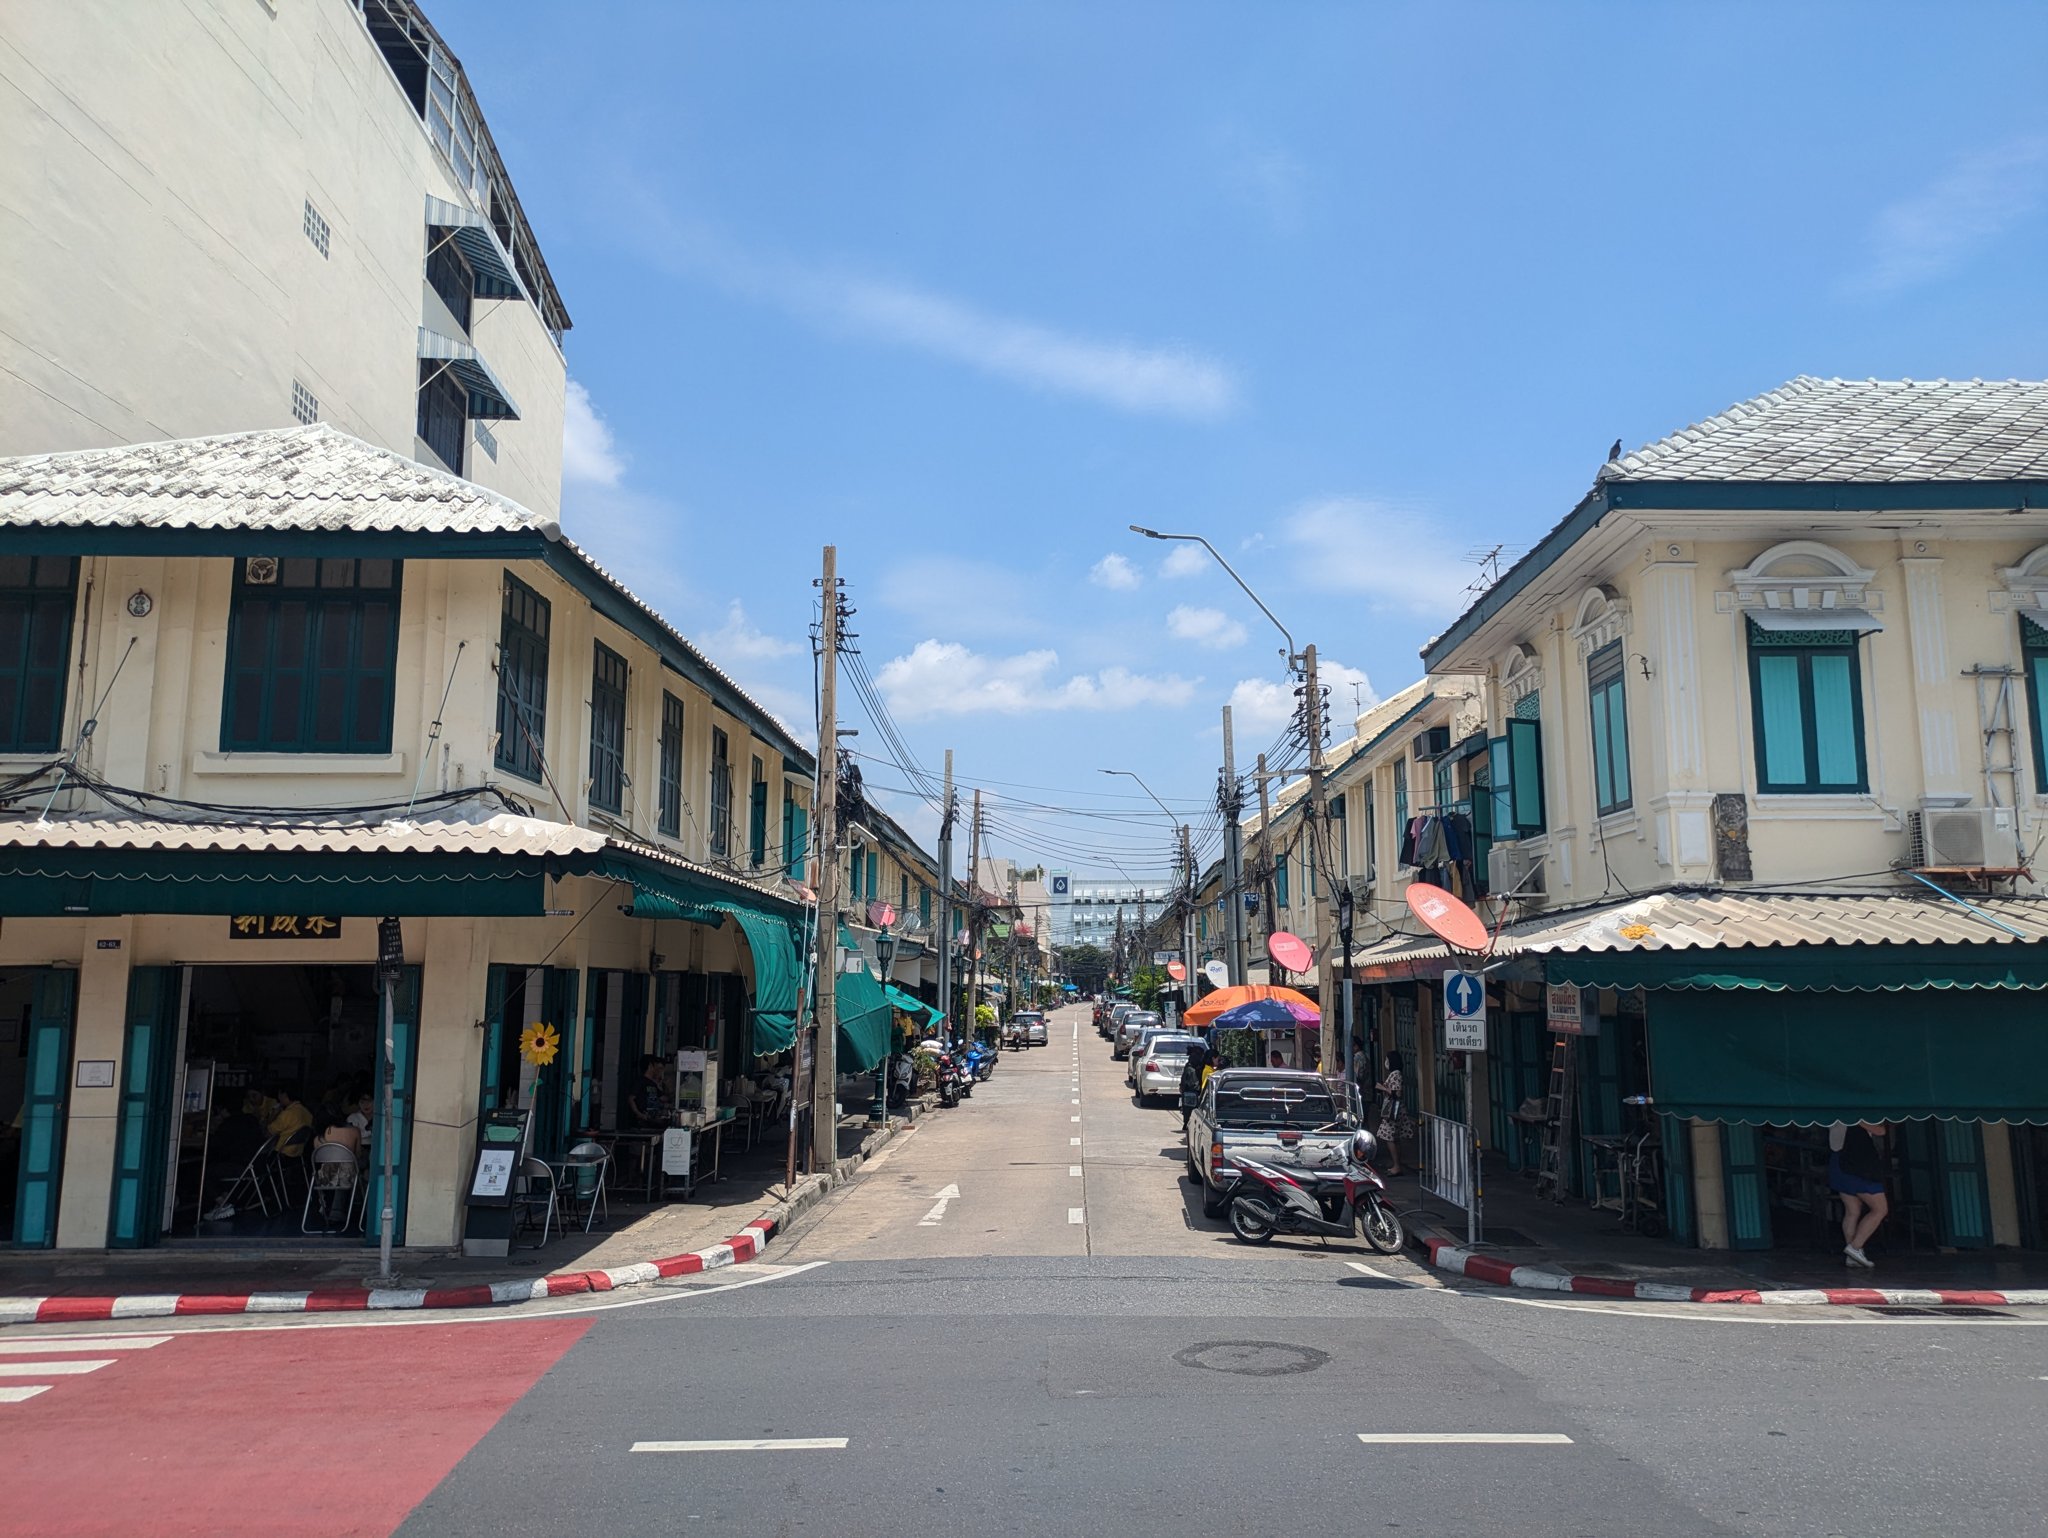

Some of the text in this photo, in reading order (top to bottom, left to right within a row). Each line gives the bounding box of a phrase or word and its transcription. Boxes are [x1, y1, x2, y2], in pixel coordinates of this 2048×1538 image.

[1452, 1021, 1478, 1033] เดินรถ
[1448, 1035, 1482, 1047] ทางเดียว
